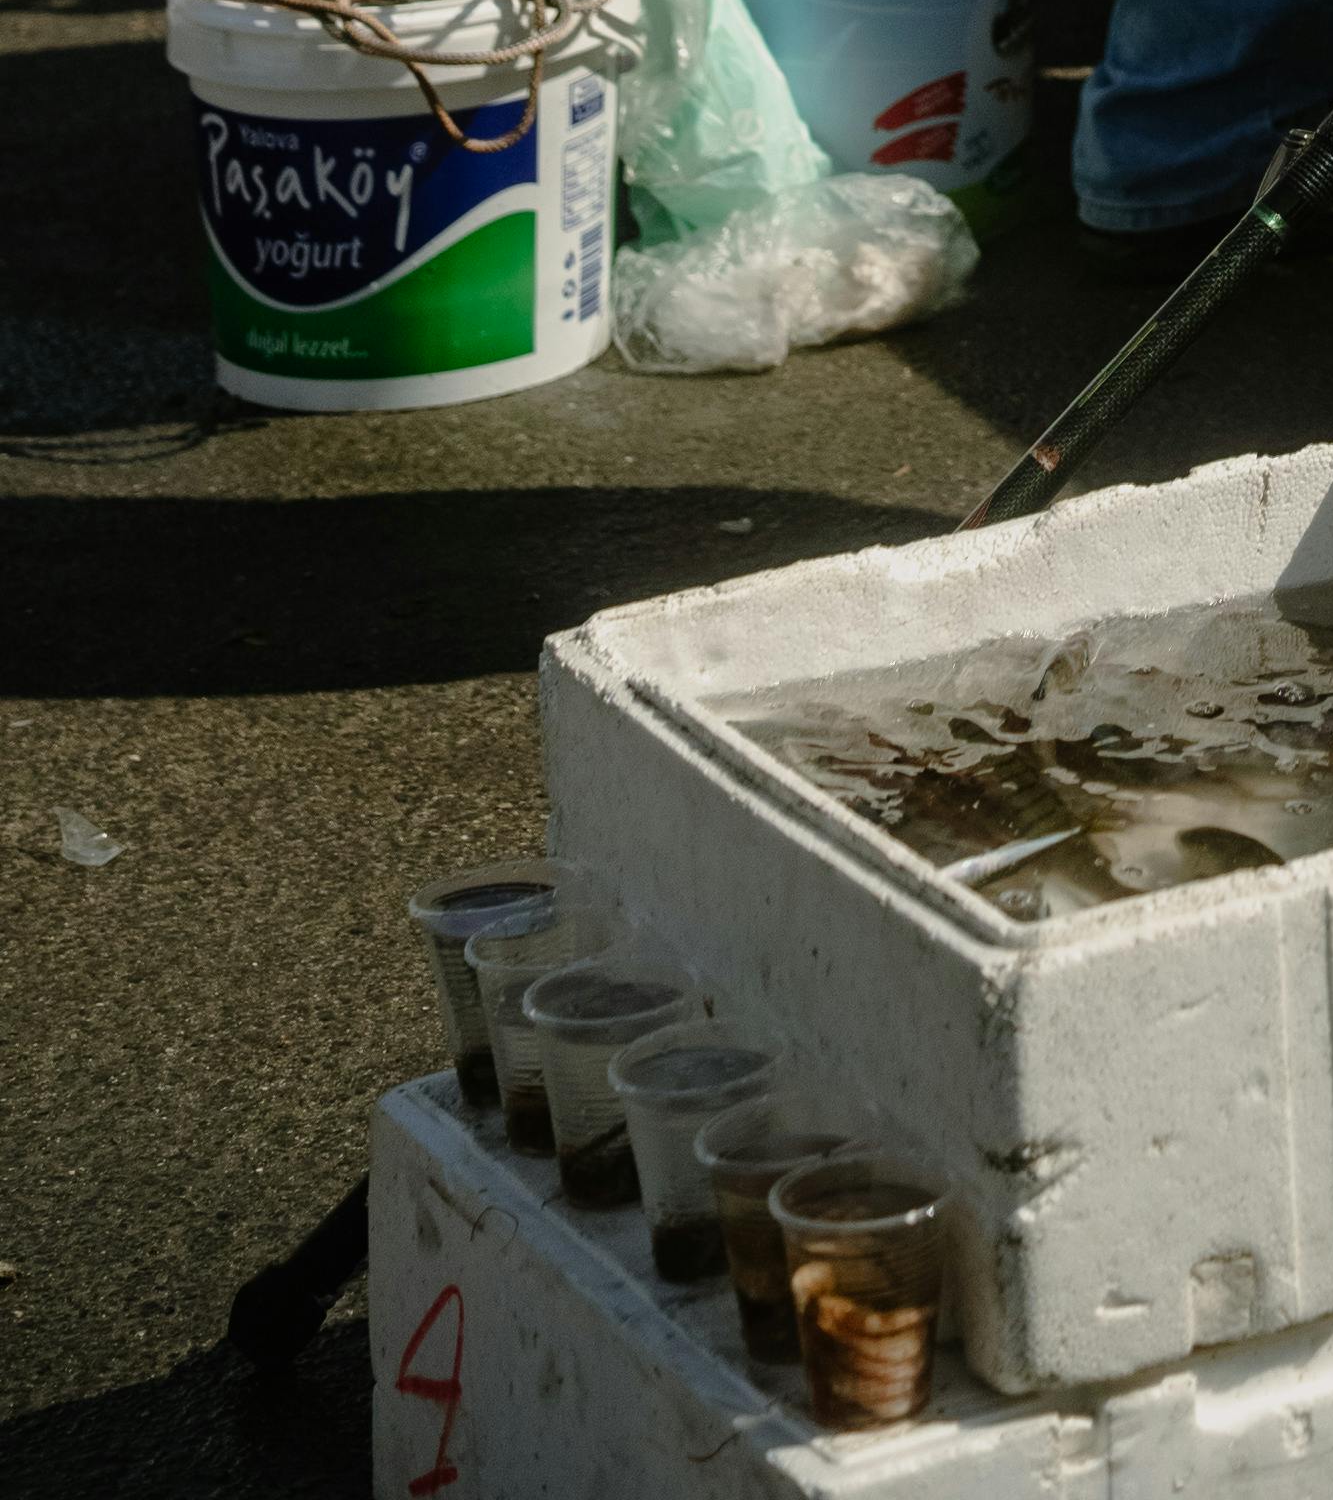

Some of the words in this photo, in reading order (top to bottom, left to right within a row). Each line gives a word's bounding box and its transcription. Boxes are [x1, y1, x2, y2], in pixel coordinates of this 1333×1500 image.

[238, 122, 300, 151] Yalova
[201, 111, 414, 253] Paşaköy
[254, 230, 364, 280] yoğurt
